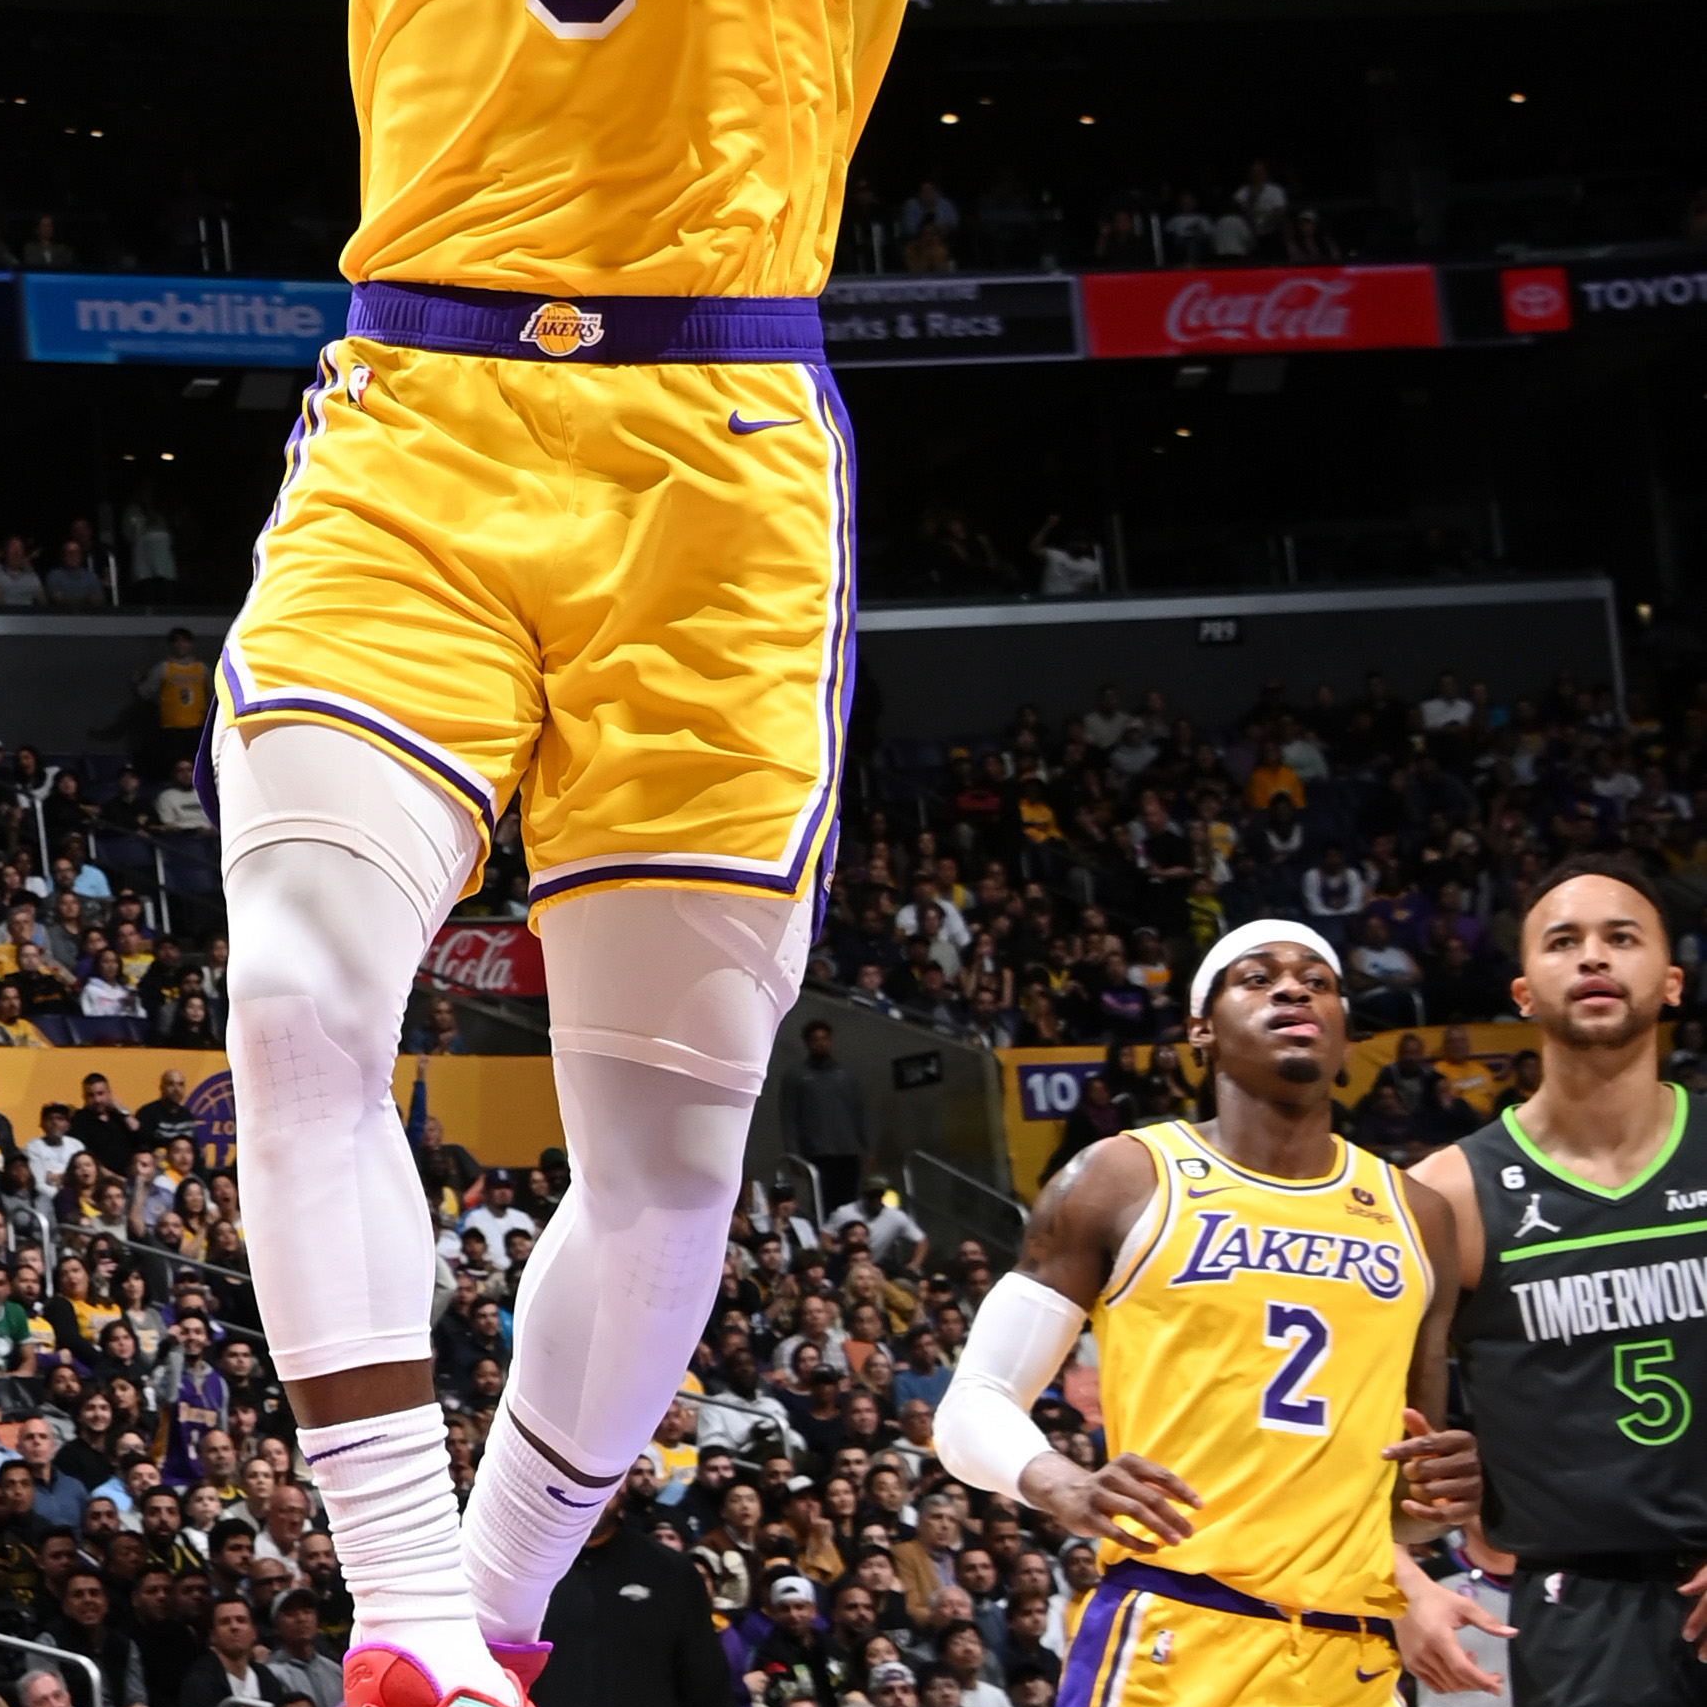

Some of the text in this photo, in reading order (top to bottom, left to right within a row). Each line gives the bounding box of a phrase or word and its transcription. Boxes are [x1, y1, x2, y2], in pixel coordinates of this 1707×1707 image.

[75, 292, 326, 338] mobilitie
[522, 314, 602, 344] LAKERS
[1025, 1070, 1084, 1114] 10
[1501, 1165, 1527, 1190] 6
[1166, 1209, 1406, 1301] LAKERS
[1257, 1299, 1332, 1437] 2
[1613, 1337, 1693, 1447] 5
